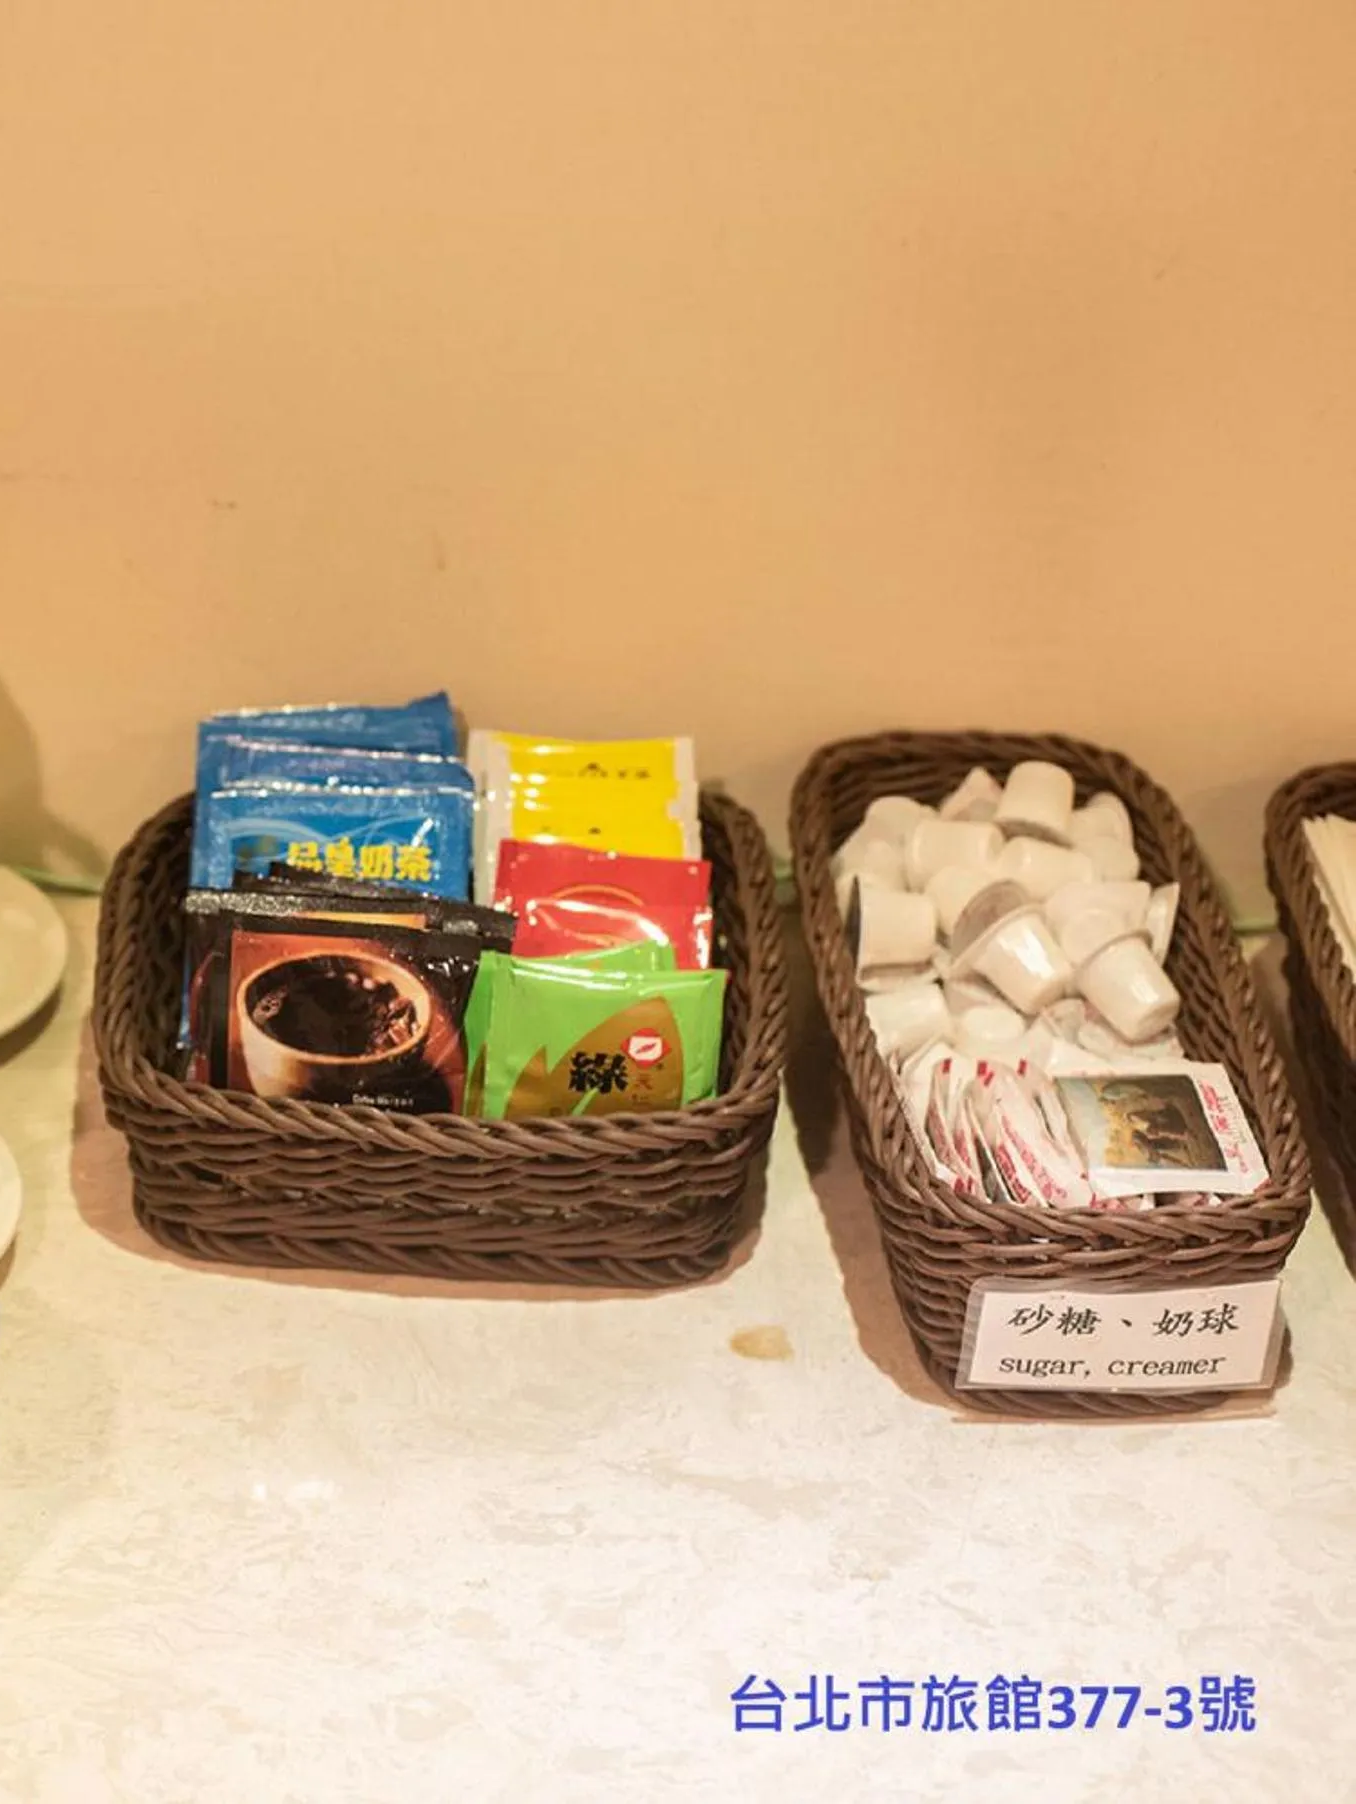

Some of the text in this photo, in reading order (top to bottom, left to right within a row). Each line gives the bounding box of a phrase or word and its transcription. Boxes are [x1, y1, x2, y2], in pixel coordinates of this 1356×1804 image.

[1008, 1302, 1240, 1337] 砂糖、奶球
[998, 1355, 1227, 1378] sugar, creamer
